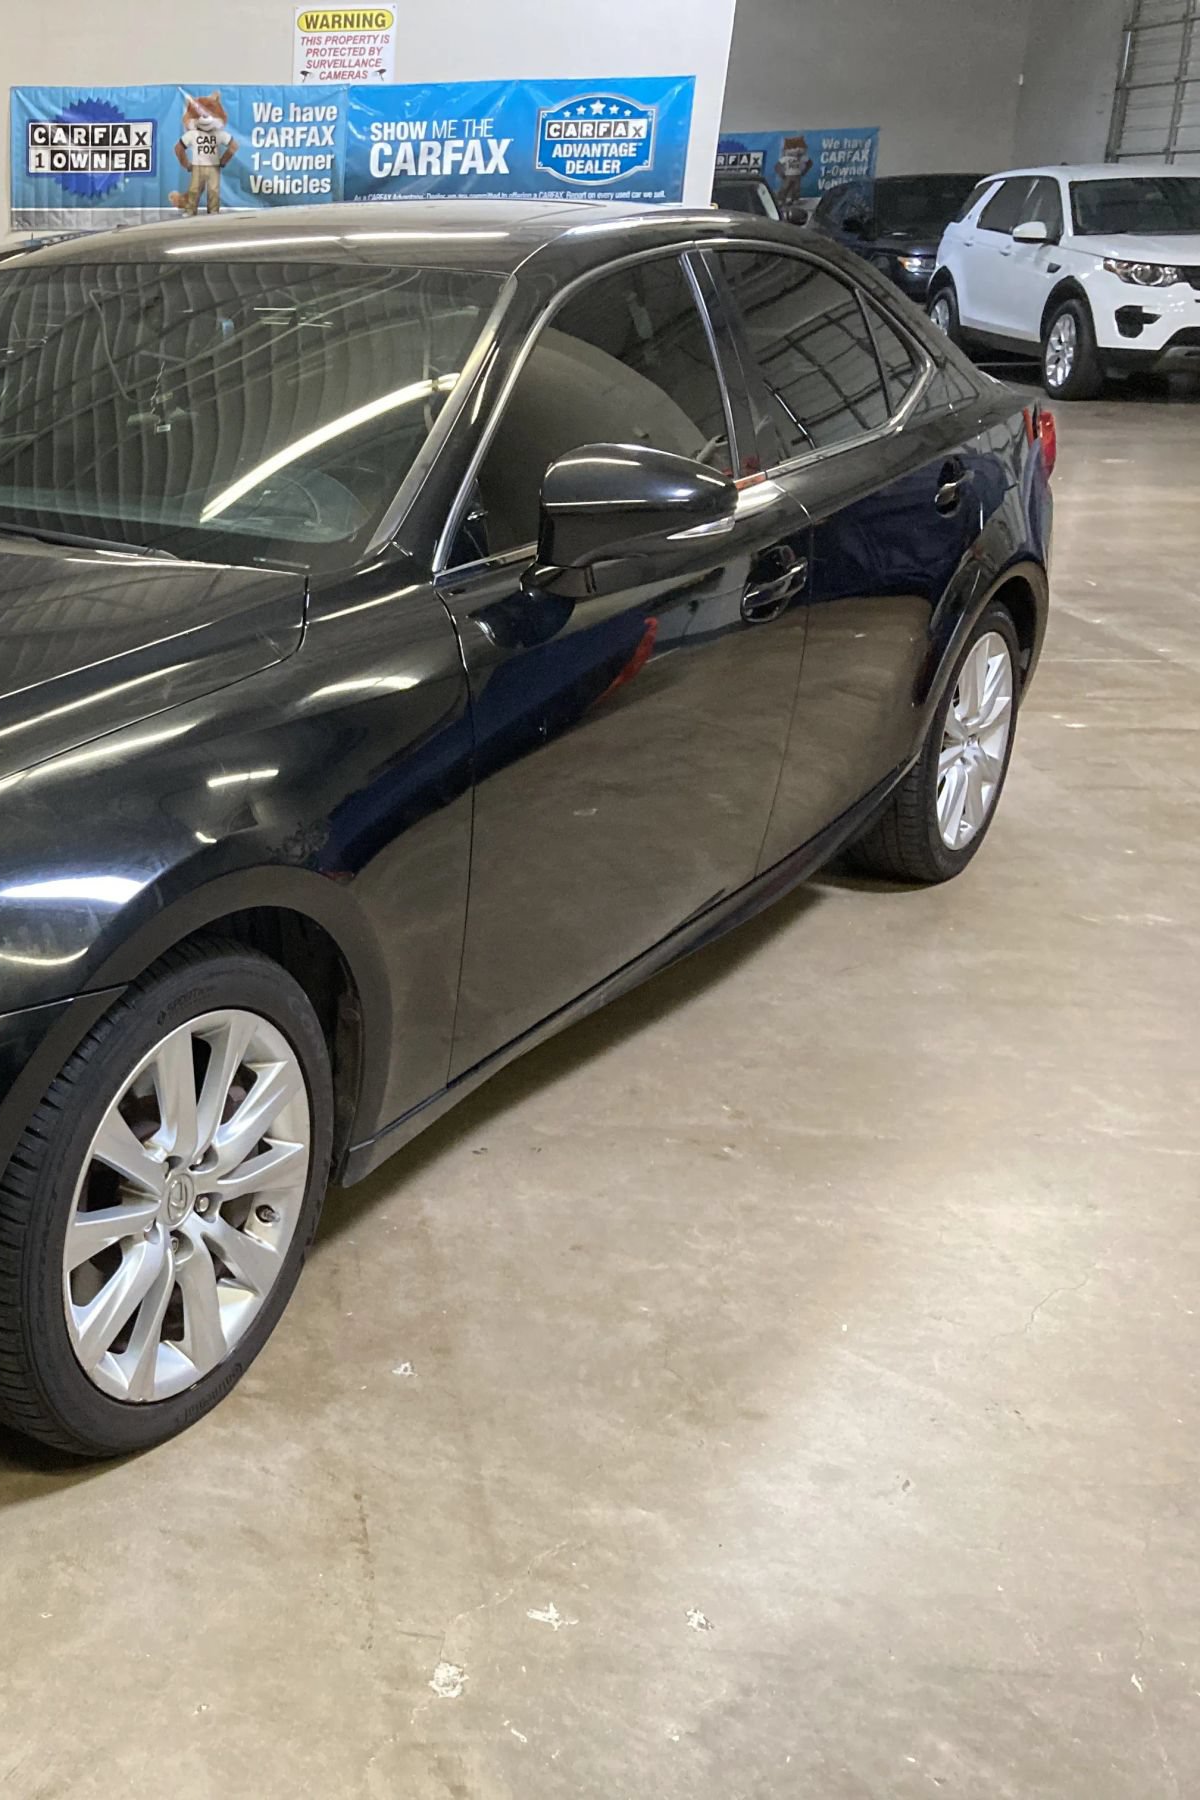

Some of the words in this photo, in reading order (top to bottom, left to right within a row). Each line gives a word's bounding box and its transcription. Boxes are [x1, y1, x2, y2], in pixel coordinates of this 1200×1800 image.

[304, 13, 386, 29] WARNING
[300, 36, 322, 46] THIS
[324, 35, 380, 45] PROPERTY
[380, 34, 391, 44] IS
[305, 47, 366, 57] PROTECTED
[368, 46, 384, 56] BY
[306, 58, 382, 69] SURVEILLANCE
[319, 70, 368, 80] CAMERAS
[252, 102, 283, 123] We
[289, 102, 338, 122] have
[32, 127, 149, 147] CARFAX
[251, 126, 335, 148] CARFAX
[370, 121, 427, 141] SHOW
[431, 120, 457, 139] ME
[462, 118, 494, 138] THE
[548, 122, 645, 139] CARFAX
[196, 135, 217, 145] CAR
[822, 138, 840, 149] We
[197, 145, 216, 155] FOX
[552, 143, 638, 158] ADVANTAGE
[820, 149, 870, 164] CARFAX
[250, 152, 335, 171] 1-Owner
[369, 138, 510, 178] CARFAX
[716, 155, 761, 166] RFAX
[565, 159, 621, 175] DEALER
[250, 174, 331, 195] Vehicles
